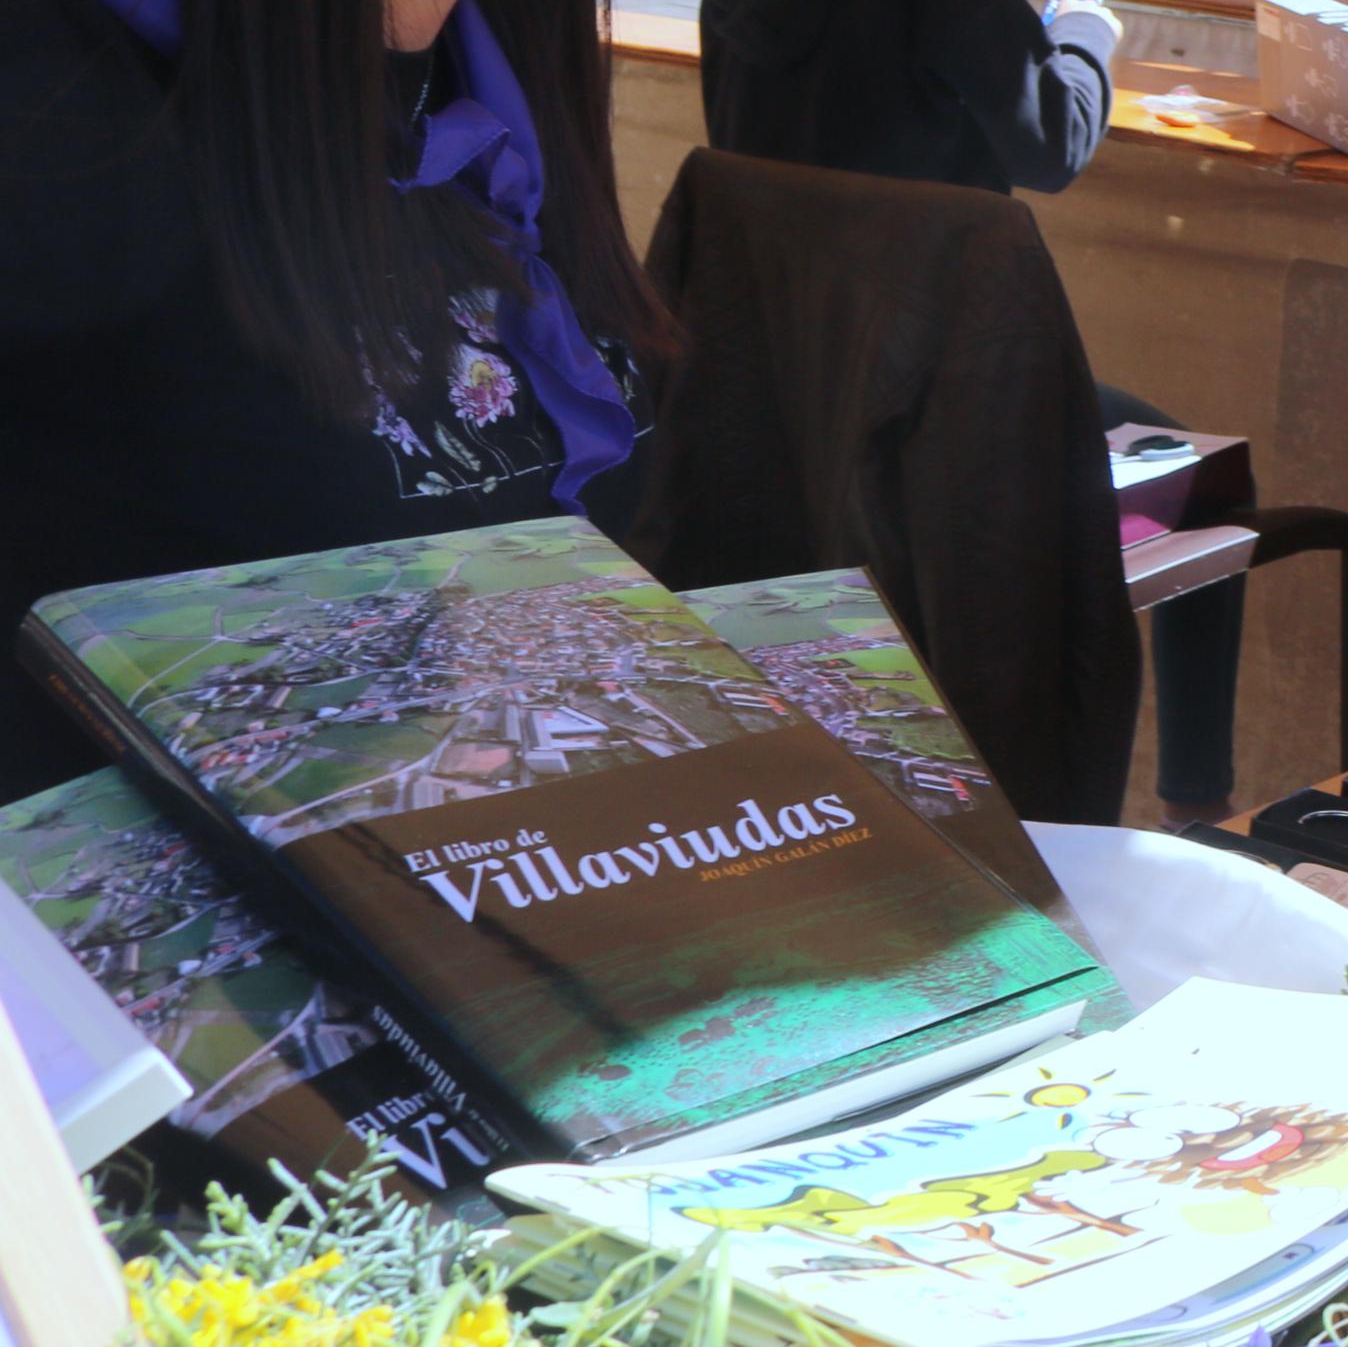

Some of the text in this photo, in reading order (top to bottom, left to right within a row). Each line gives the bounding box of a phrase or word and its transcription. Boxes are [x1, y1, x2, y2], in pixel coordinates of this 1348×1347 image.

[404, 827, 550, 874] El libro de
[420, 792, 857, 923] Villaviudas
[700, 854, 774, 883] JOAQUÍN
[776, 839, 832, 867] GALÁN
[372, 1004, 467, 1113] Villaviudas
[346, 1092, 435, 1143] El libr
